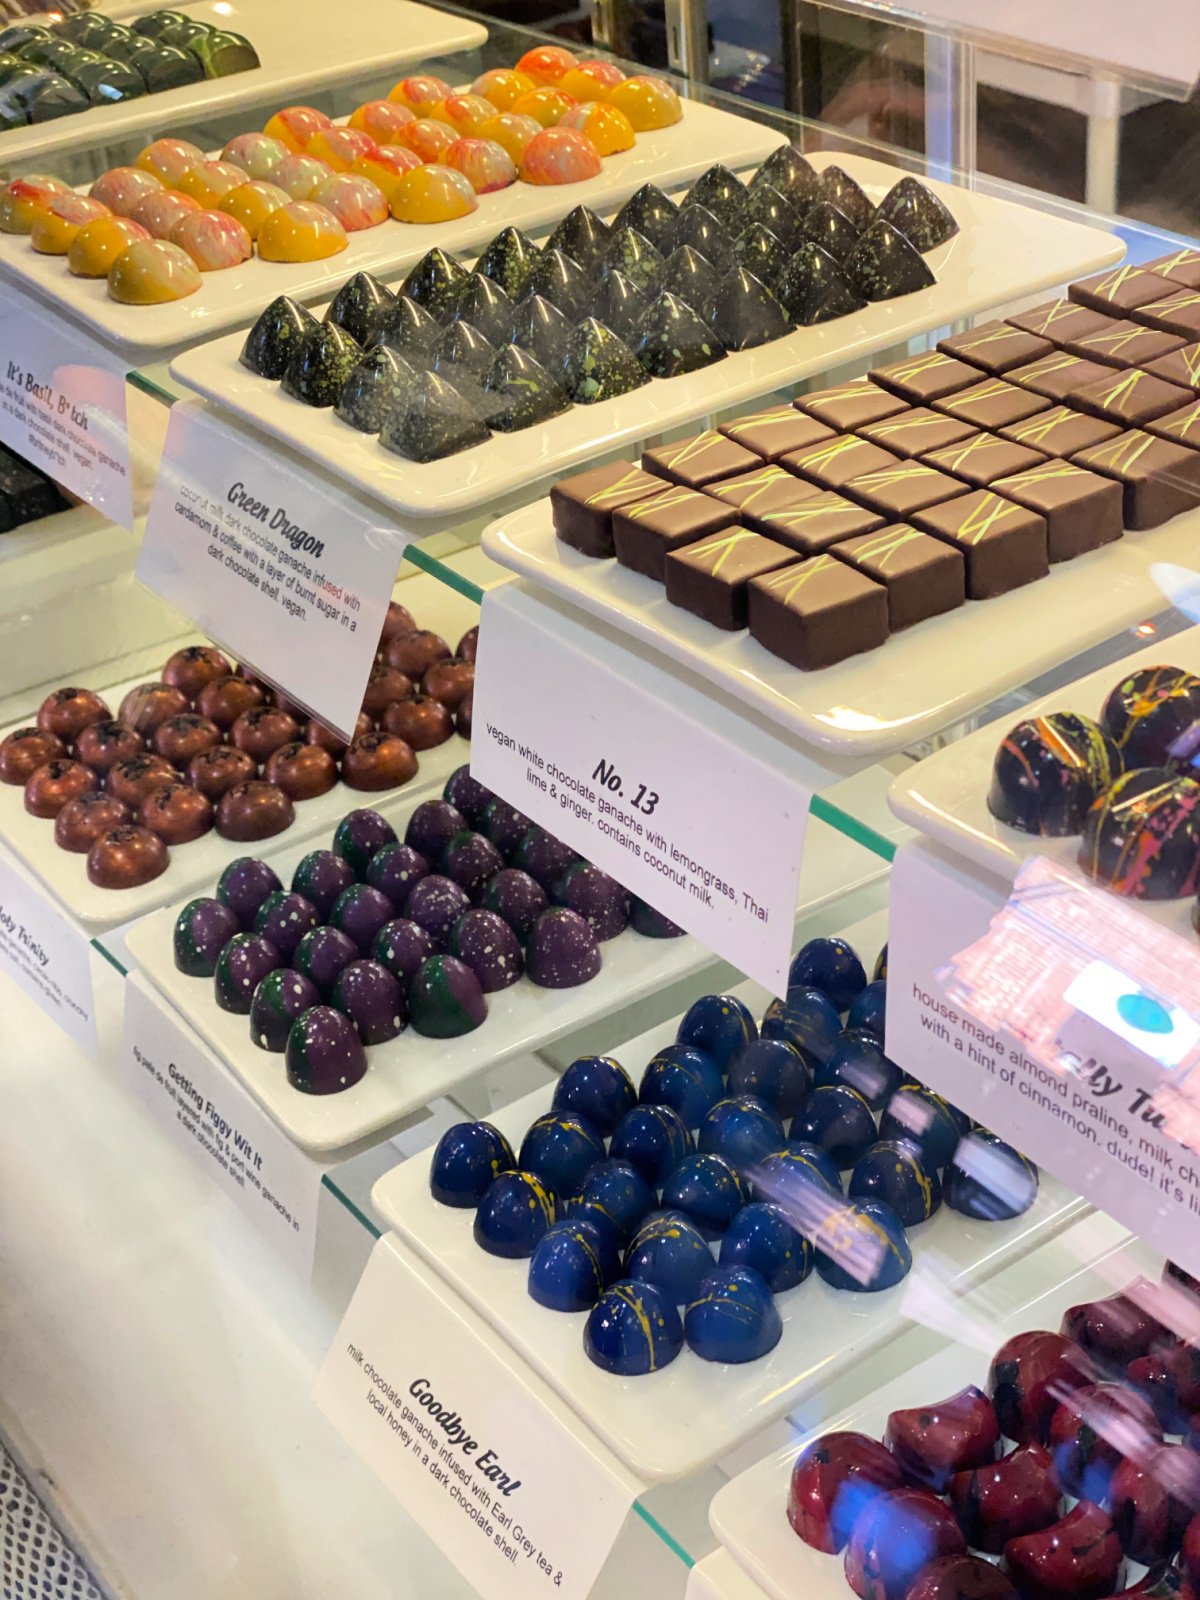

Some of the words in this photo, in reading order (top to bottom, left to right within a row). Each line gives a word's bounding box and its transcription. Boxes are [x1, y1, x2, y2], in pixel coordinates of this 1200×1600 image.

[7, 361, 23, 386] It's
[25, 374, 54, 410] Basil,
[174, 502, 212, 534] cardamom
[213, 527, 219, 538] &
[219, 531, 242, 554] coffee
[243, 548, 258, 566] with
[259, 560, 265, 570] a
[266, 560, 285, 584] layer
[286, 576, 296, 589] of
[296, 582, 316, 605] burnt
[317, 598, 340, 623] sugar
[341, 612, 350, 628] in
[350, 622, 357, 632] a
[179, 485, 209, 510] coconut
[225, 513, 242, 532] dark
[242, 525, 278, 556] chocolate
[277, 550, 312, 579] ganache
[313, 570, 343, 599] infused
[344, 591, 361, 612] with
[207, 544, 224, 563] dark
[225, 553, 260, 588] chocolate
[260, 580, 280, 602] shell.
[281, 595, 306, 621] vegan.
[227, 482, 270, 522] Green
[269, 508, 325, 558] Dragon
[485, 723, 516, 753] vegan
[518, 745, 544, 769] white
[546, 762, 596, 804] chocolate
[597, 797, 644, 836] ganache
[645, 828, 668, 854] with
[669, 843, 738, 906] lemongrass,
[742, 892, 769, 923] Thai
[526, 768, 548, 792] lime
[550, 784, 558, 798] &
[560, 792, 594, 826] ginger.
[597, 819, 641, 856] contains
[643, 851, 687, 889] coconut
[688, 880, 715, 910] milk.
[592, 759, 624, 797] No.
[630, 784, 660, 816] 13
[18, 926, 50, 966] Trinity
[168, 1063, 204, 1110] Getting
[205, 1102, 232, 1138] Figgy
[235, 1130, 254, 1160] Wit
[253, 1154, 263, 1171] It
[912, 983, 960, 1023] house
[961, 1014, 1005, 1055] made
[1008, 1047, 1069, 1098] almond
[1071, 1091, 1133, 1144] praline,
[1138, 1136, 1174, 1171] milk
[920, 1013, 951, 1043] with
[954, 1035, 965, 1052] a
[968, 1041, 996, 1075] hint
[999, 1065, 1018, 1089] of
[1019, 1075, 1103, 1148] cinnamon.
[1106, 1139, 1156, 1185] dude!
[1159, 1172, 1185, 1203] it's
[346, 1343, 364, 1367] milk
[363, 1361, 402, 1409] chocolate
[401, 1405, 439, 1450] ganache
[439, 1444, 471, 1486] infused
[471, 1482, 491, 1508] with
[491, 1503, 512, 1530] Earl
[512, 1525, 537, 1558] Grey
[537, 1552, 552, 1576] tea
[553, 1572, 563, 1587] &
[366, 1389, 387, 1416] local
[386, 1411, 413, 1447] honey
[412, 1440, 423, 1458] in
[422, 1454, 429, 1466] a
[429, 1457, 450, 1488] dark
[450, 1484, 493, 1536] chocolate
[494, 1531, 518, 1566] shell.
[409, 1378, 478, 1454] Goodbye
[475, 1450, 521, 1497] Earl
